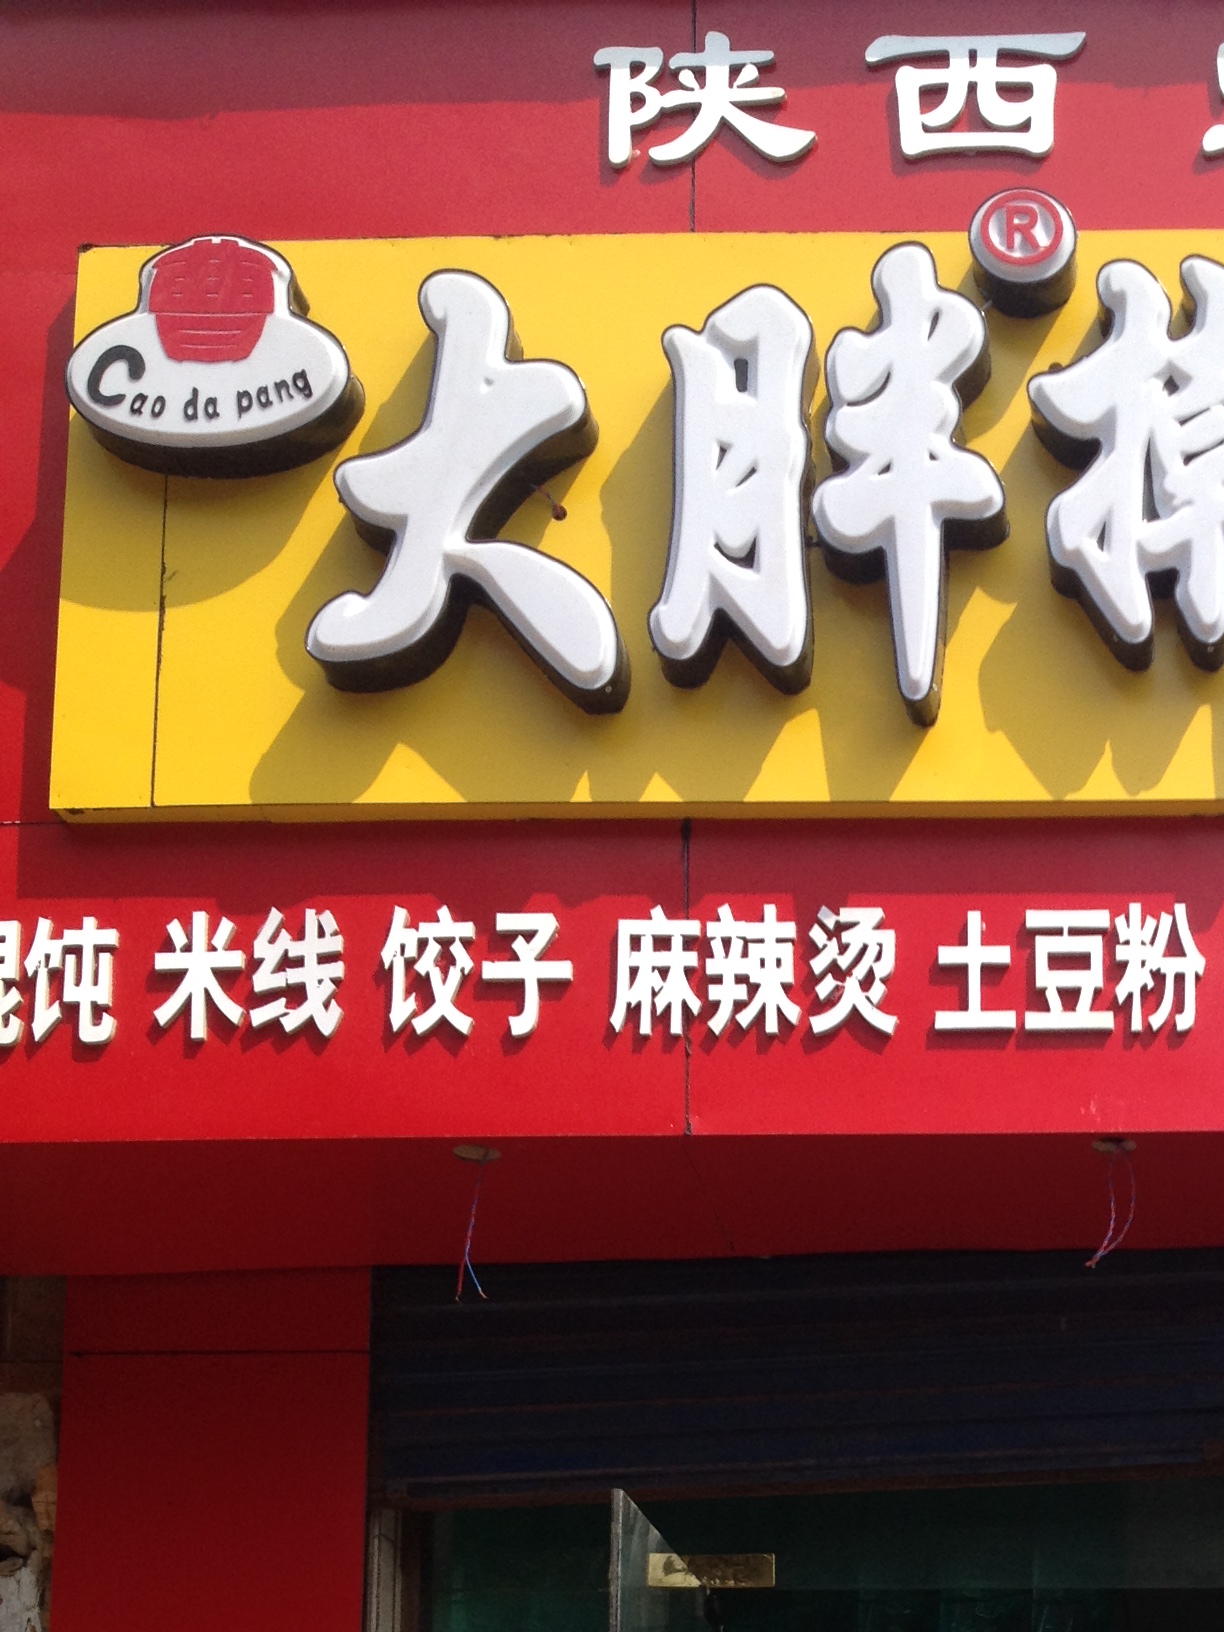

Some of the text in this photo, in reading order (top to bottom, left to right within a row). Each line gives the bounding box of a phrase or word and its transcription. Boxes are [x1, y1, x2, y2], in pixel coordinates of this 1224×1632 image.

[87, 345, 314, 421] Cao da pang
[0, 915, 120, 1046] 饨
[153, 907, 345, 1040] 米线
[380, 904, 574, 1037] 饺子
[609, 903, 899, 1037] 麻辣烫
[934, 901, 1207, 1033] 土豆粉
